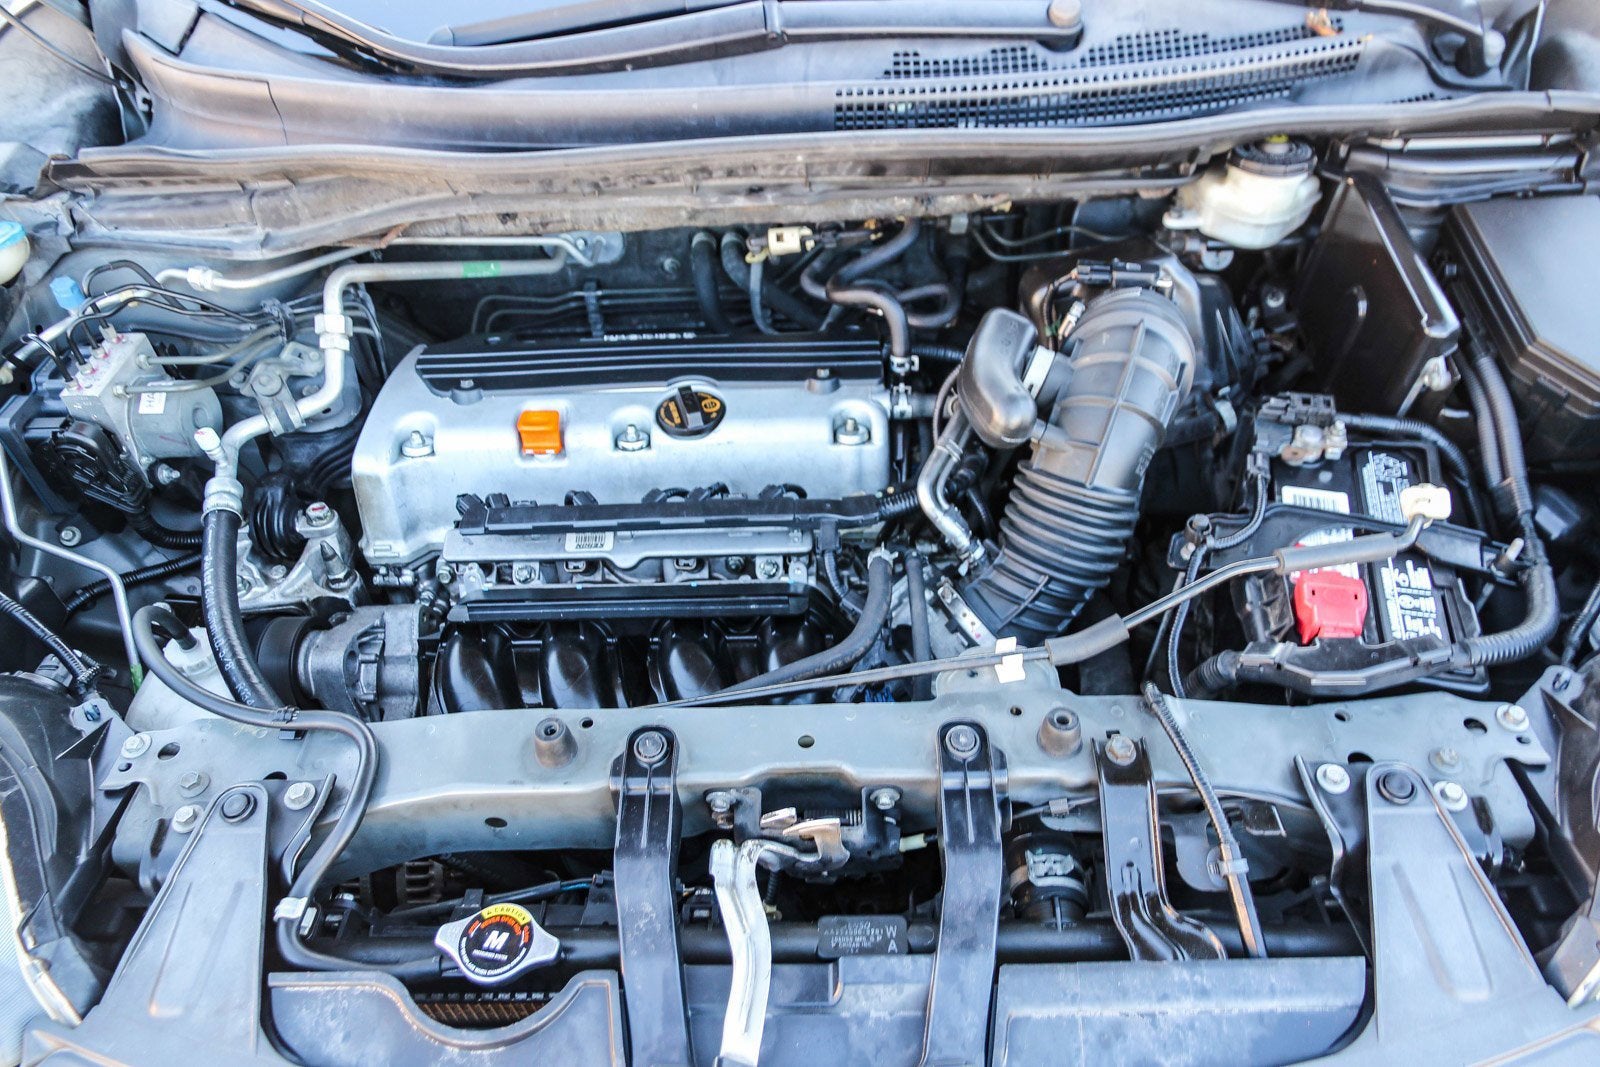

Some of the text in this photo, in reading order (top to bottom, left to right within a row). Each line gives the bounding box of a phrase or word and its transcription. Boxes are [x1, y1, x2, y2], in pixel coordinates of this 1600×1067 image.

[494, 907, 526, 921] CAUTION
[886, 925, 897, 938] W
[481, 930, 510, 951] M
[888, 939, 898, 953] A
